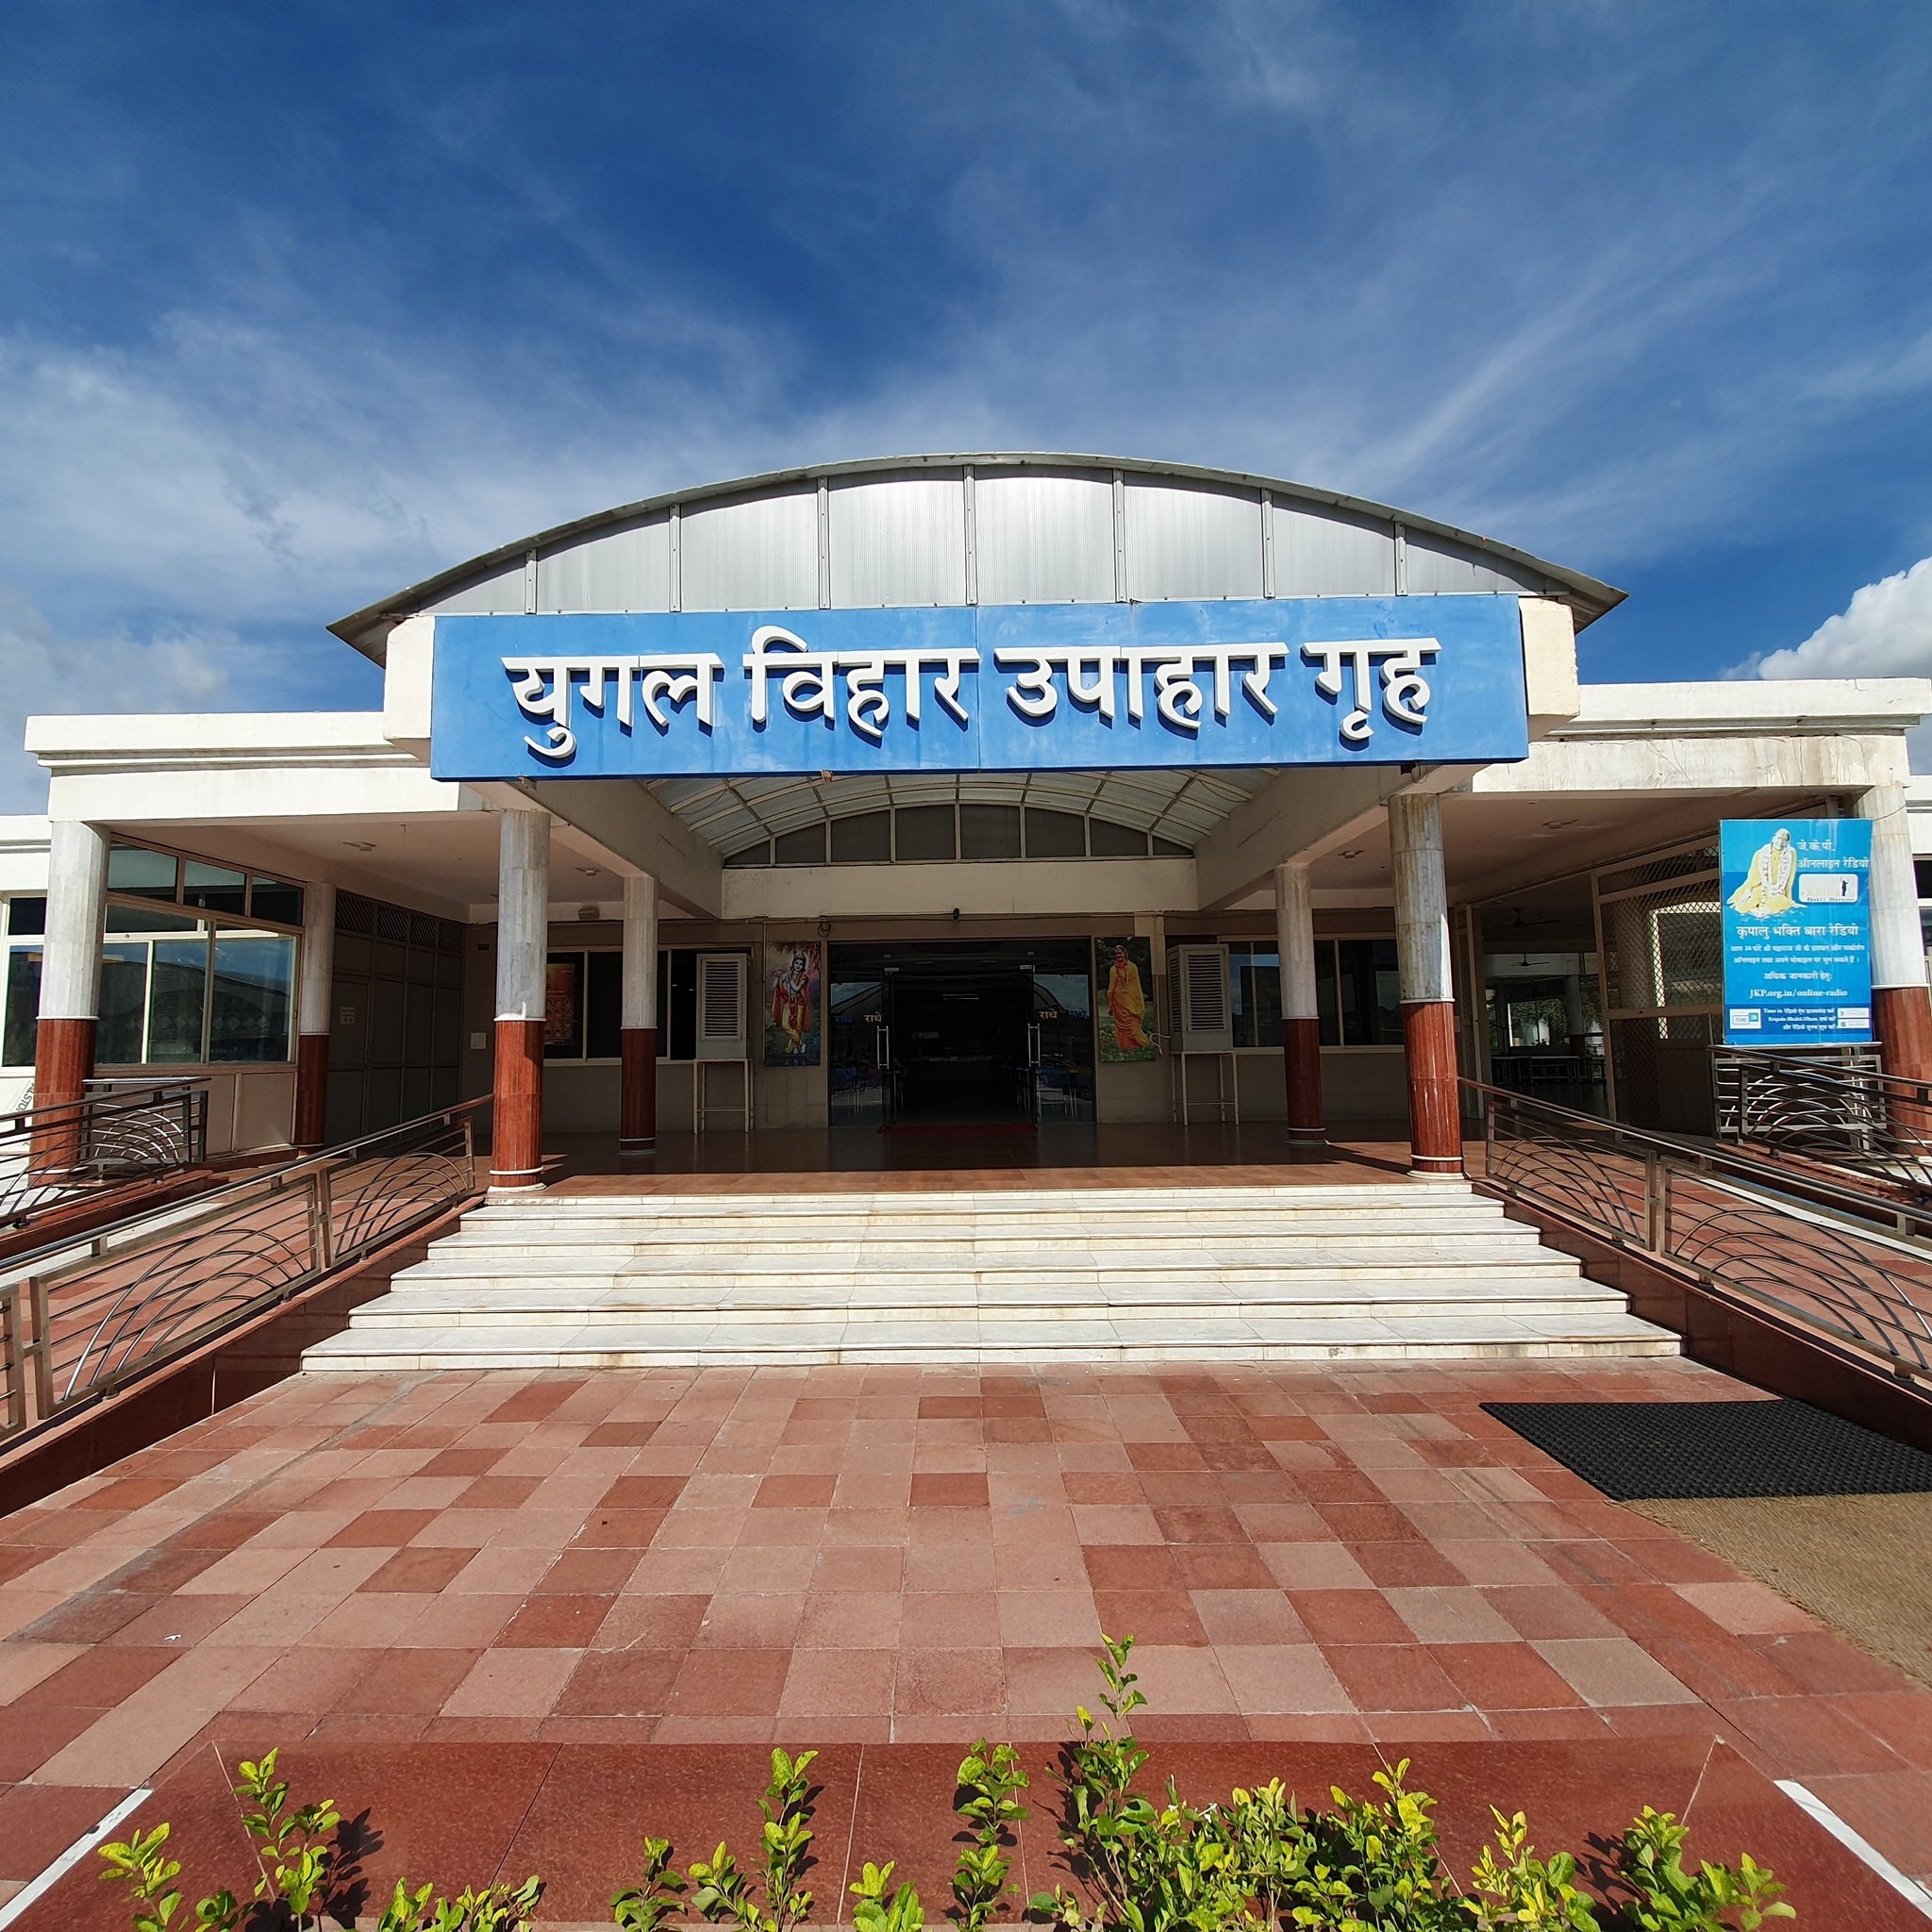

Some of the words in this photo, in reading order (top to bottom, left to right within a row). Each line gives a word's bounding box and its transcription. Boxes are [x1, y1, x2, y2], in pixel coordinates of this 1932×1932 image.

[501, 653, 724, 758] युगल
[742, 629, 980, 738] विहार
[993, 641, 1291, 729] उपाहार
[1301, 637, 1442, 741] गृह
[1798, 857, 1840, 870] ऑनलाइन
[1842, 856, 1870, 869] रेडियो
[1736, 926, 1771, 940] कृपालु
[1773, 923, 1801, 937] भक्ति
[1828, 923, 1859, 937] रेडियो
[863, 1011, 883, 1024] राधे
[1038, 1008, 1058, 1021] राधे
